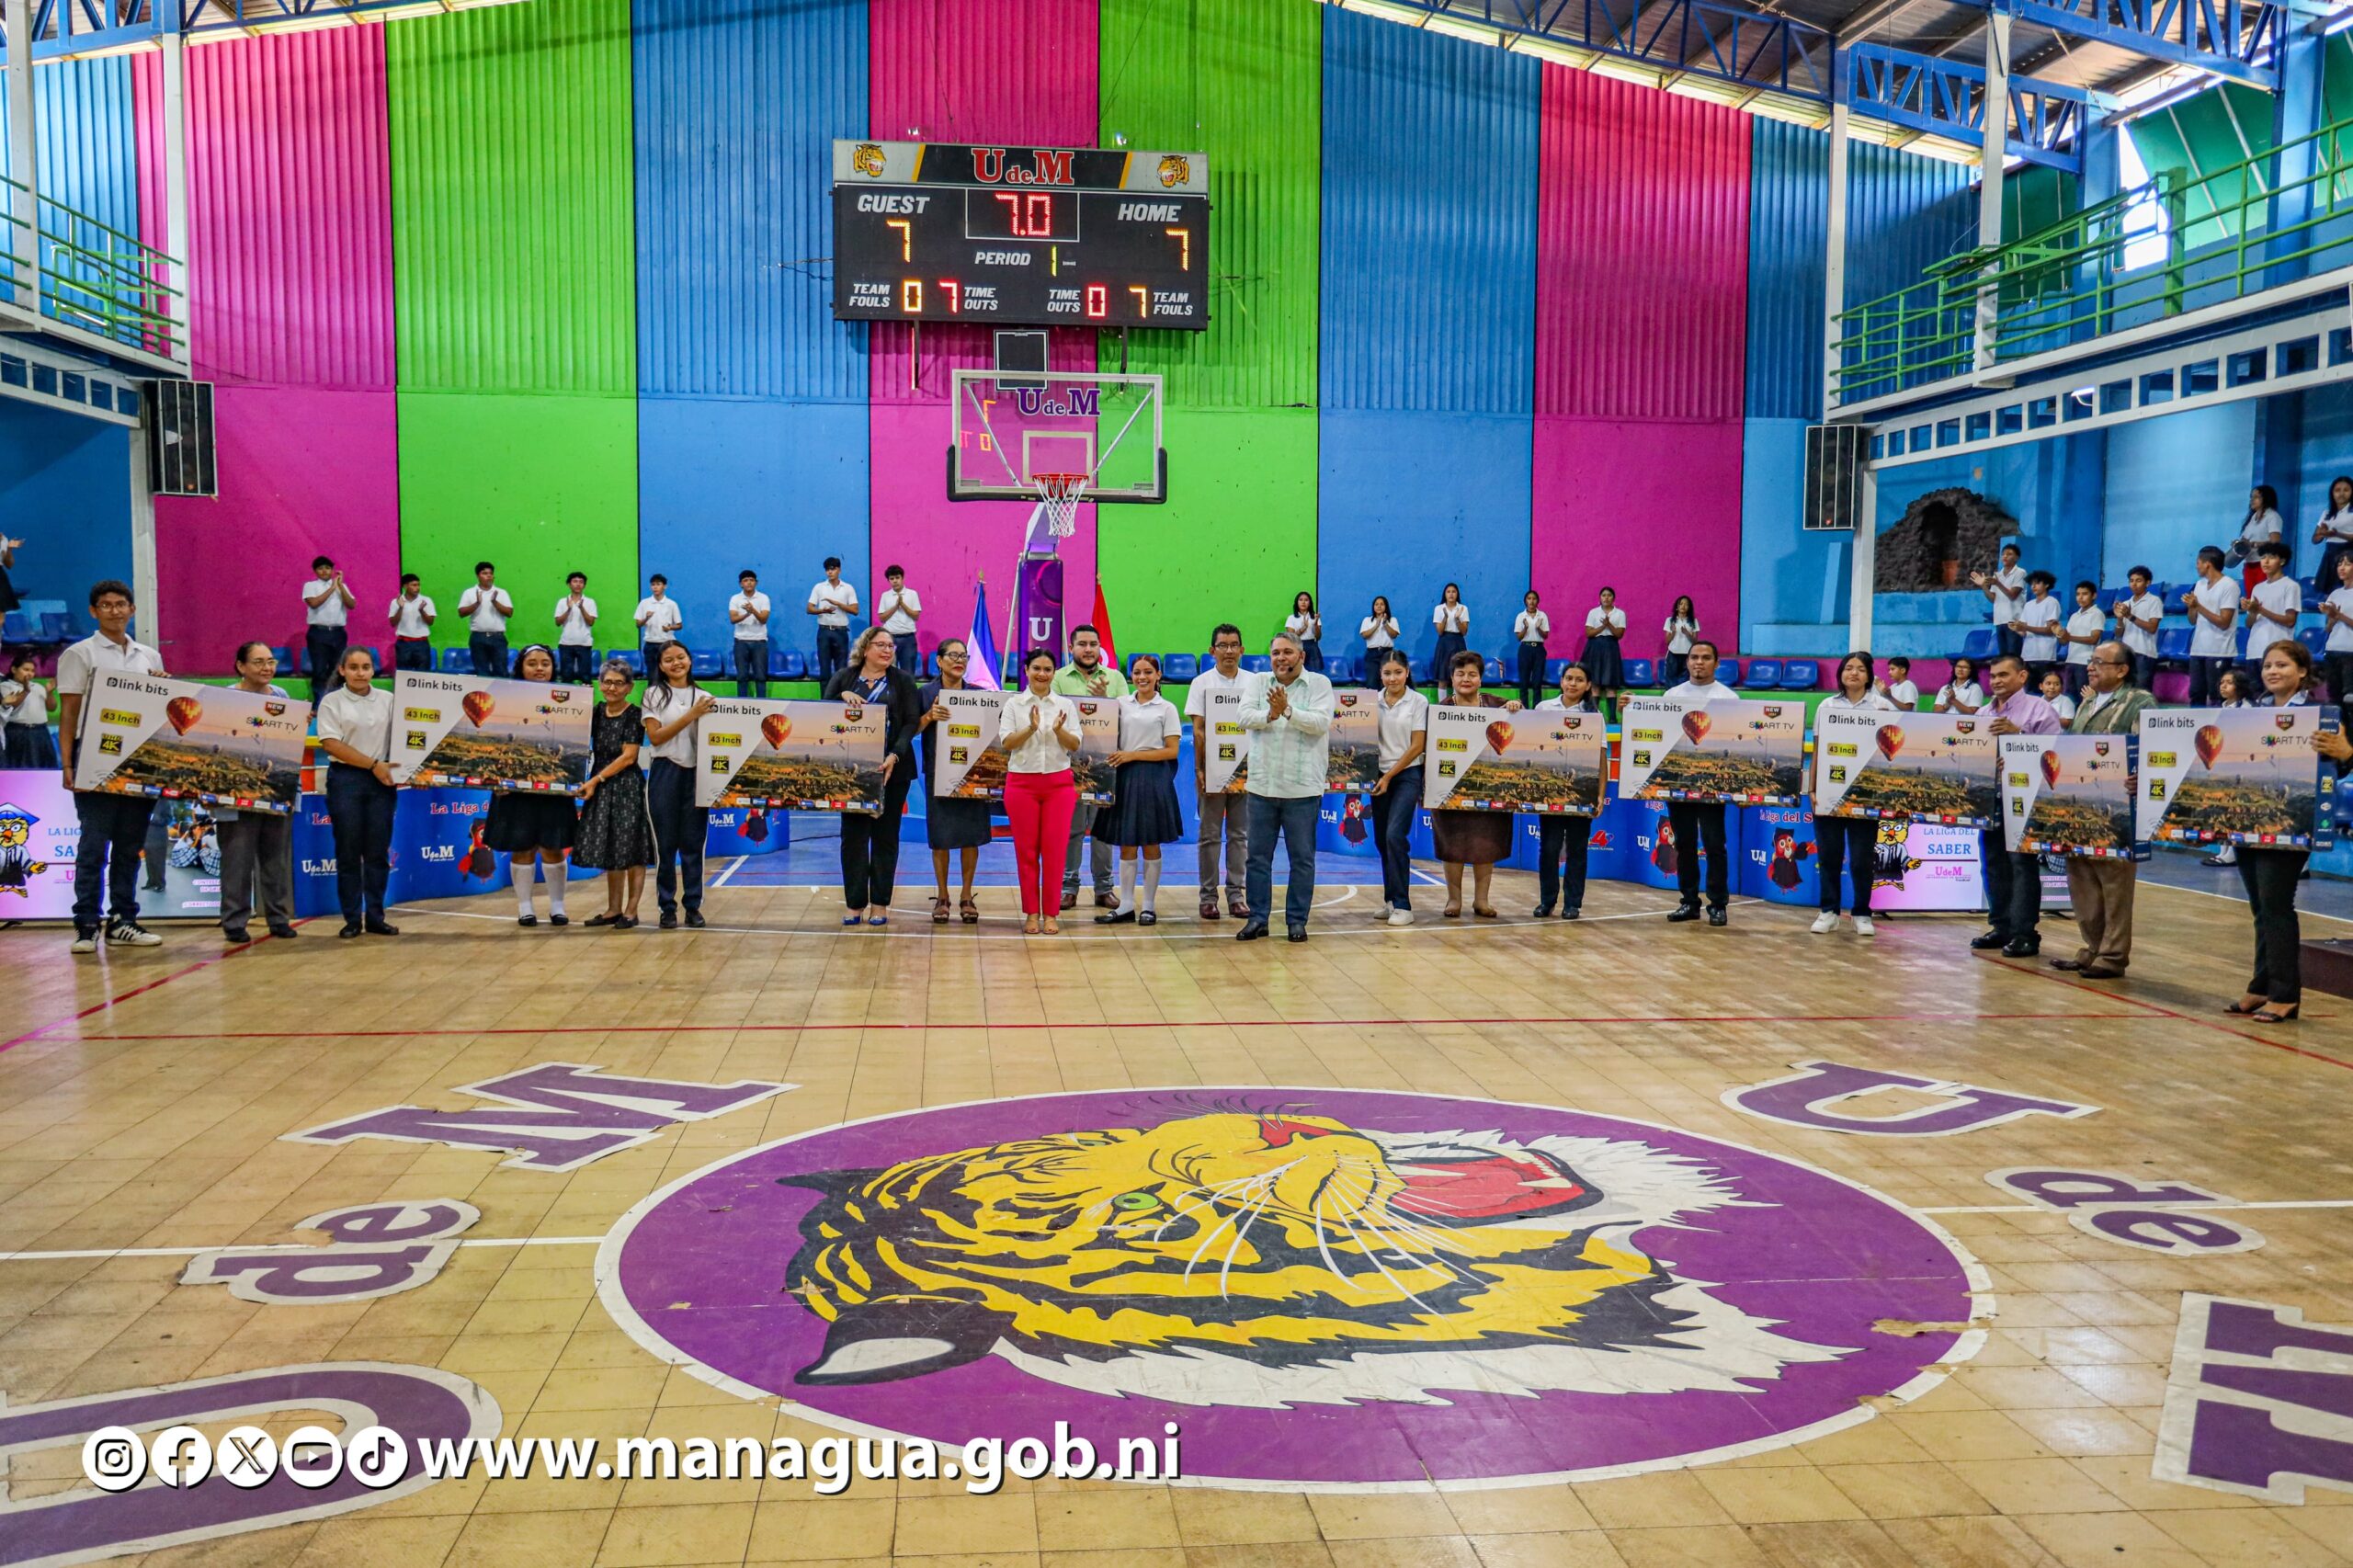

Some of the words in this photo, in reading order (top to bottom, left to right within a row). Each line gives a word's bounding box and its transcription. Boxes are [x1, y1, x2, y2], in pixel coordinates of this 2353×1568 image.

[857, 194, 930, 214] GUEST
[1117, 203, 1182, 222] HOME
[886, 220, 911, 263] 7
[1165, 229, 1188, 271] 7
[974, 251, 1031, 267] PERIOD
[853, 283, 891, 296] TEAM
[963, 287, 996, 299] TIME
[1049, 289, 1081, 301] TIME
[903, 280, 922, 312] 0
[938, 280, 958, 313] 7
[1087, 286, 1106, 317] 0
[1153, 291, 1188, 303] TEAM
[848, 295, 891, 309] FOULS
[963, 299, 998, 311] OUTS
[1047, 301, 1081, 313] OUTS
[1128, 287, 1146, 318] 7
[1153, 303, 1193, 316] FOULS
[145, 683, 169, 696] bits
[442, 681, 462, 691] bits
[980, 697, 999, 708] bits
[1664, 703, 1682, 712] bits
[570, 708, 584, 716] TV
[742, 705, 761, 715] bits
[103, 712, 115, 721] 43
[1468, 712, 1486, 722] bits
[1858, 716, 1876, 726] bits
[284, 722, 298, 731] TV
[2177, 717, 2195, 728] bits
[409, 736, 424, 746] 4K
[1581, 733, 1593, 741] TV
[1976, 738, 1988, 747] TV
[2296, 736, 2308, 744] TV
[102, 741, 119, 751] 4K
[952, 751, 966, 761] 4K
[1221, 749, 1234, 757] 4K
[1635, 755, 1648, 764] 4K
[713, 761, 727, 770] 4K
[1440, 765, 1453, 774] 4K
[1831, 770, 1844, 779] 4K
[2151, 785, 2164, 796] 4K
[430, 802, 449, 814] La
[451, 801, 479, 816] Liga
[1782, 812, 1800, 824] del
[48, 828, 66, 836] LA
[69, 828, 82, 836] LIG
[1927, 844, 1972, 855] SABER
